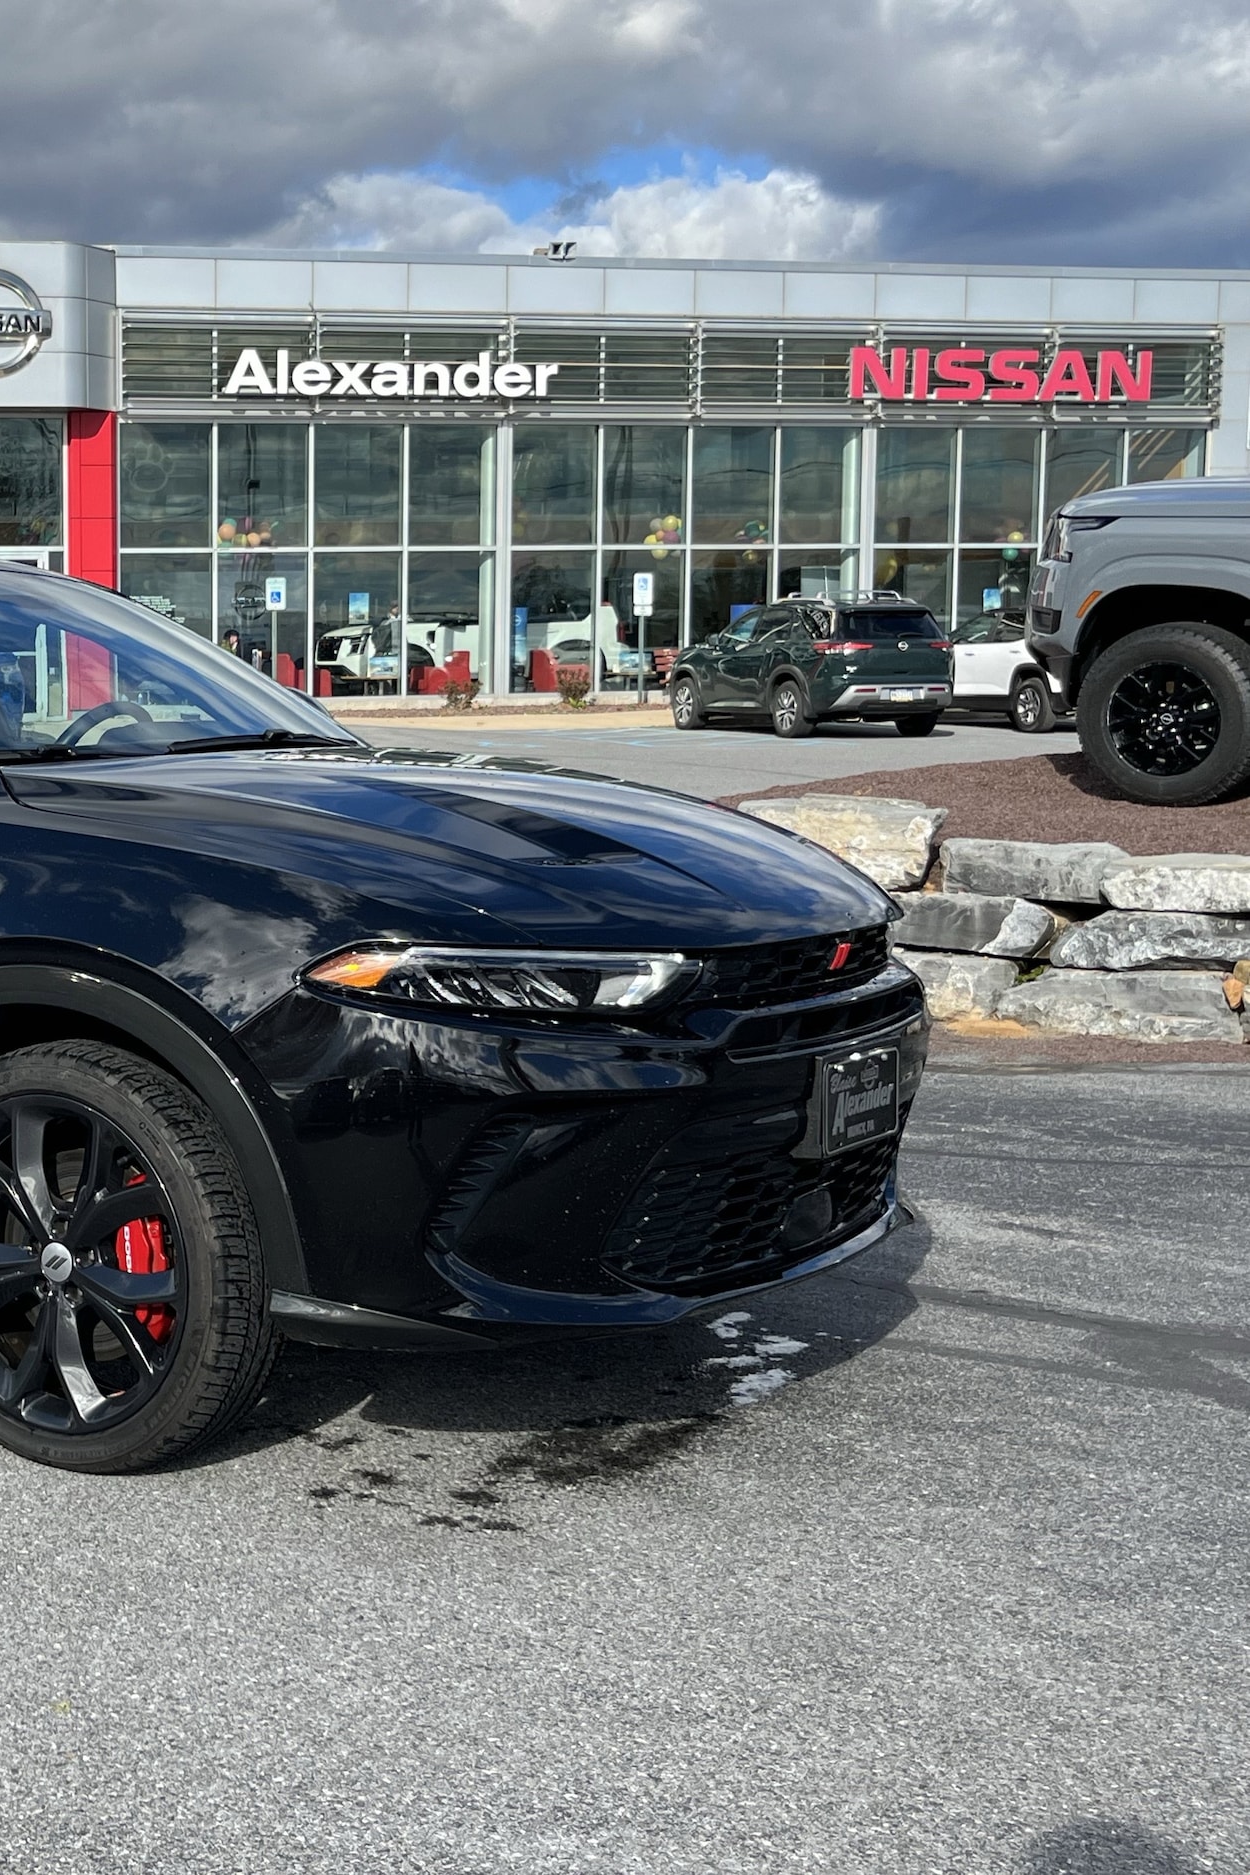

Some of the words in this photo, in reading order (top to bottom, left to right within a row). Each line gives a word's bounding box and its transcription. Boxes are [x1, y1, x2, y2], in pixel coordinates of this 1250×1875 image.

[224, 348, 559, 397] Alexander
[849, 346, 1153, 402] NISSAN
[832, 1082, 894, 1136] Alexander
